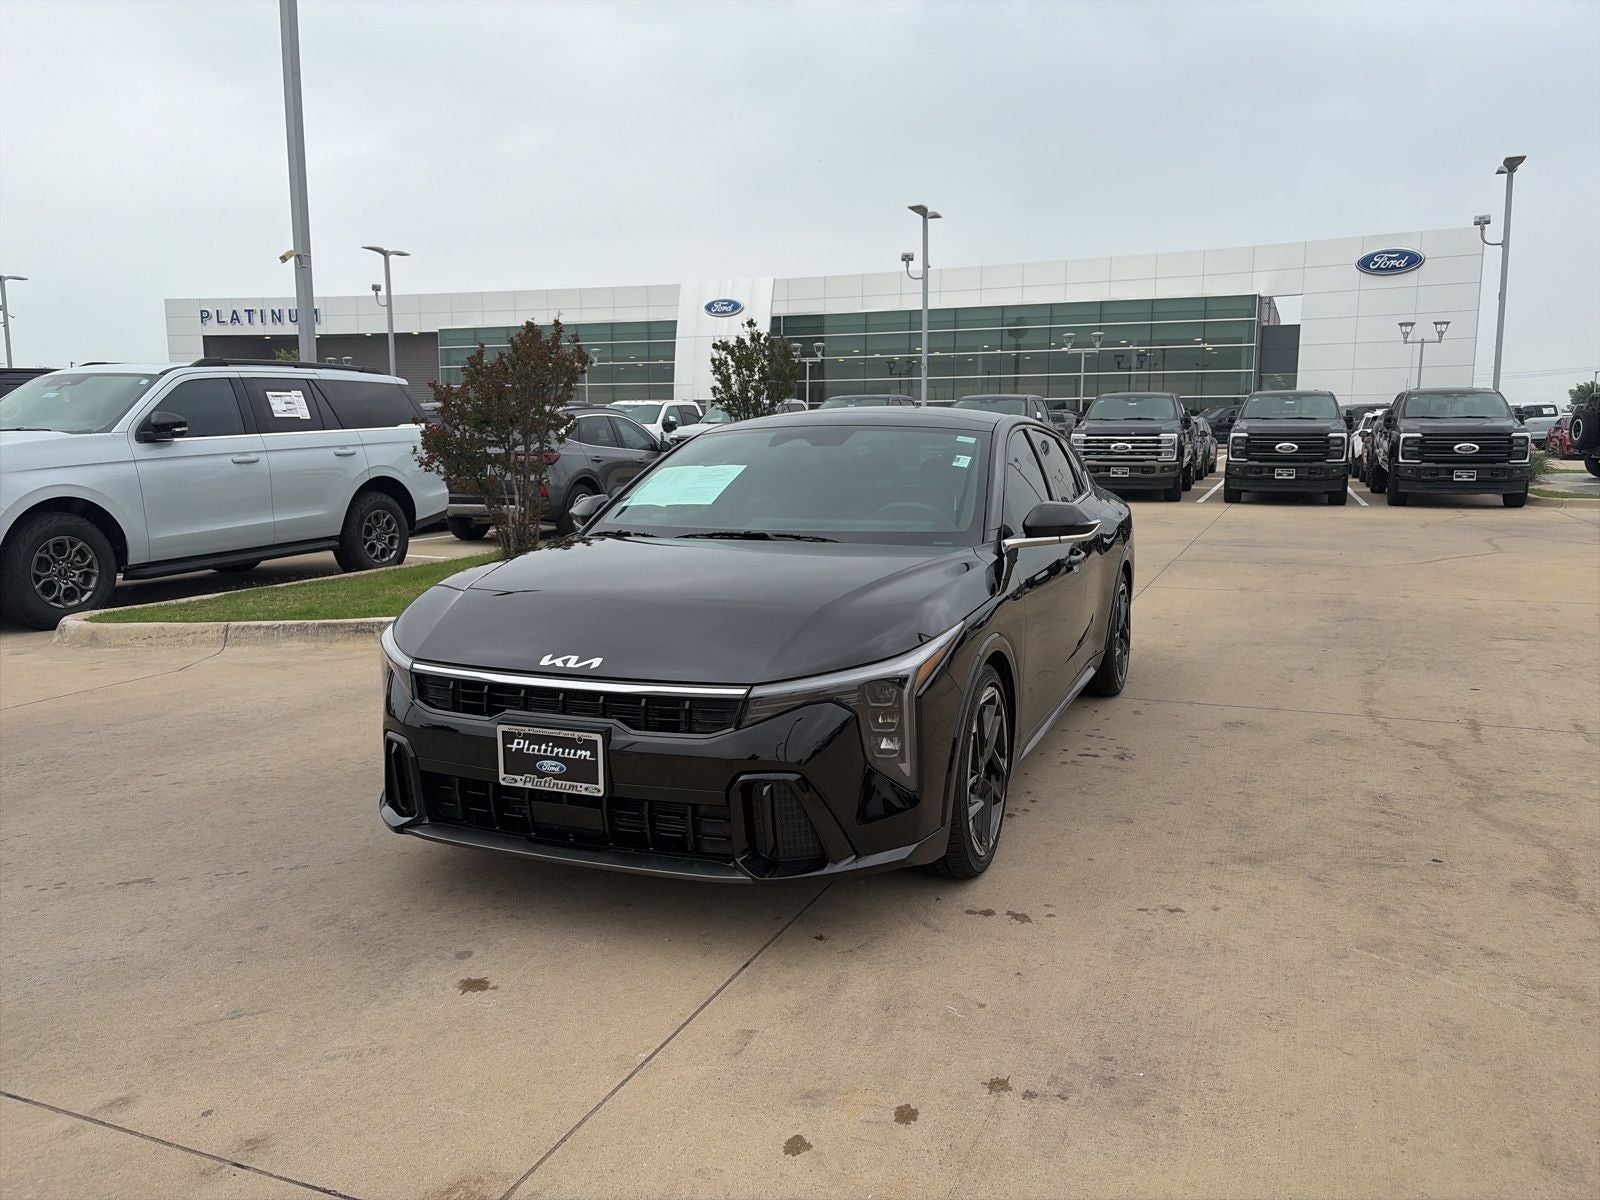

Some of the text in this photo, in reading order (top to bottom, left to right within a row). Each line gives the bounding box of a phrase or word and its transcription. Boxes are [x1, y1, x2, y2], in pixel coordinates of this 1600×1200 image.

[1370, 253, 1409, 269] Ford
[711, 301, 734, 312] Ford
[539, 653, 603, 669] KIA
[506, 739, 596, 760] Platinum
[541, 761, 560, 772] Ford
[523, 774, 583, 792] Platinum
